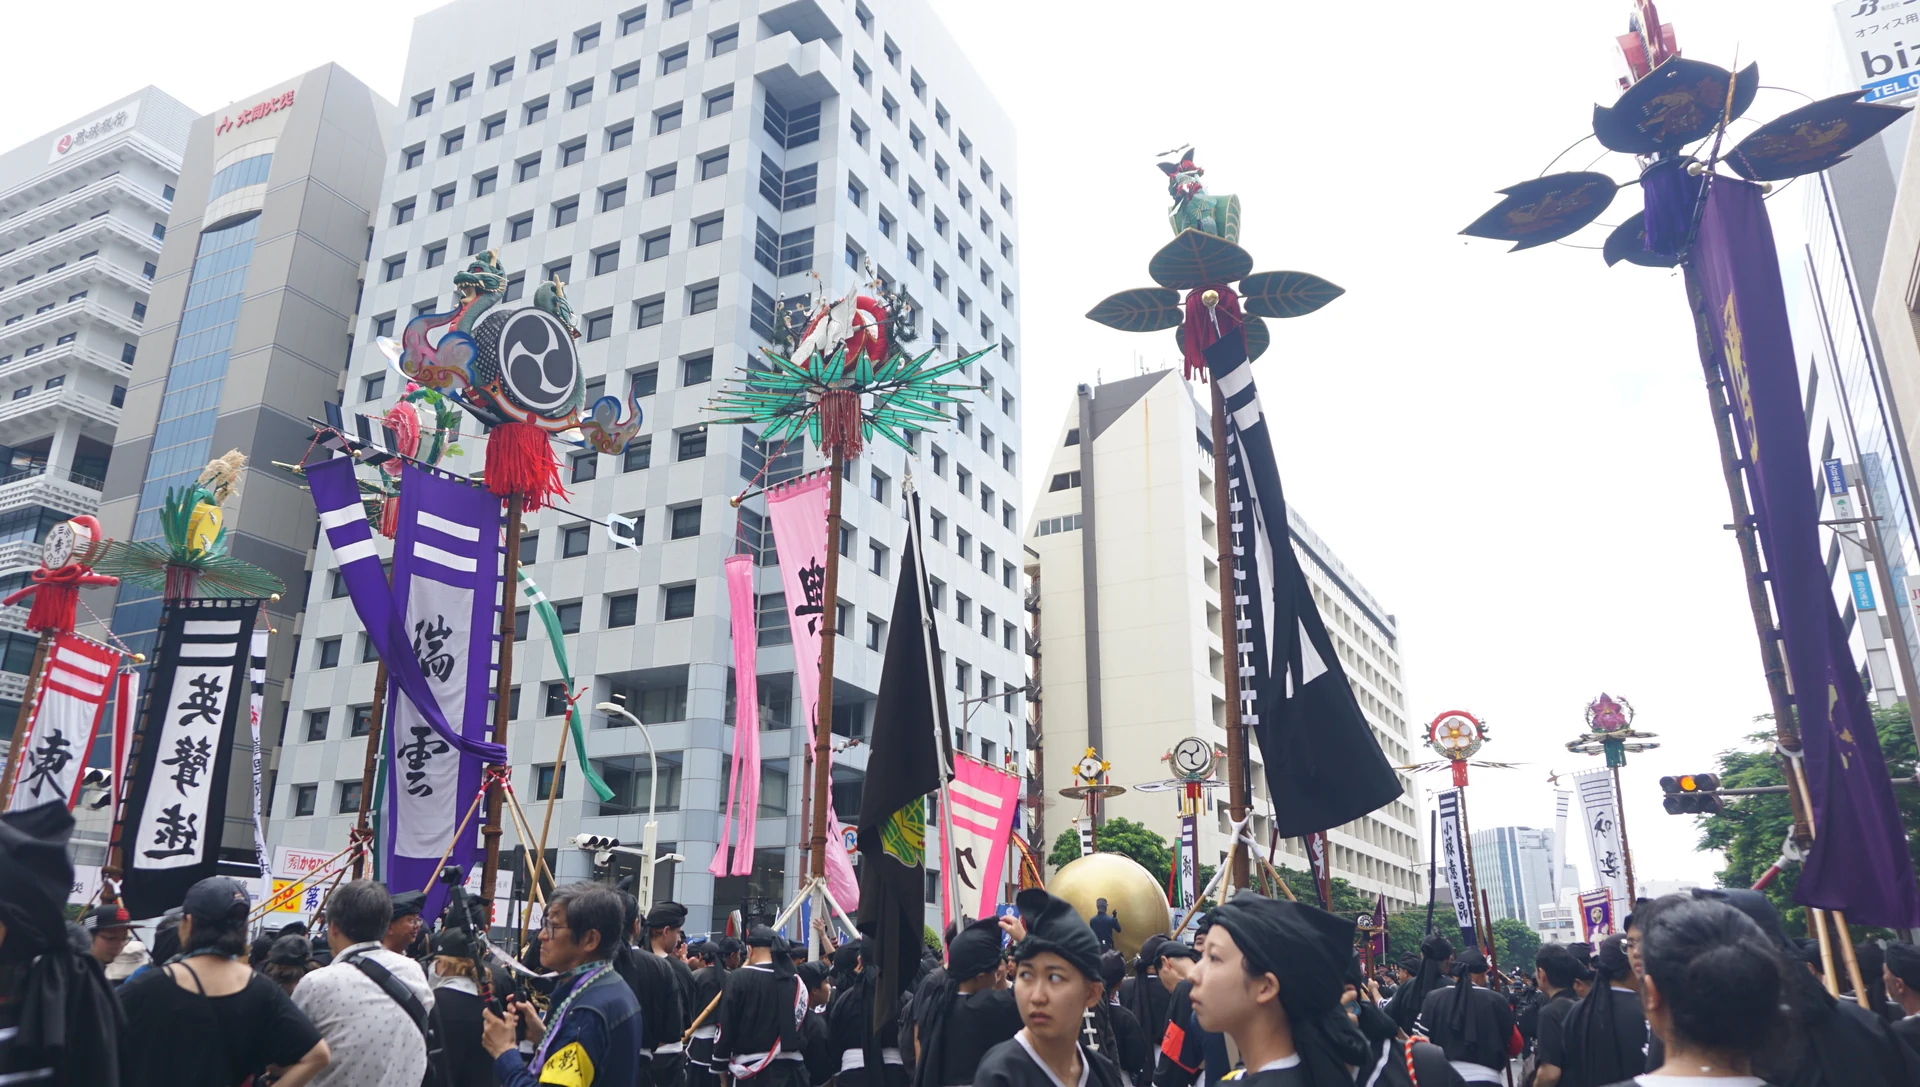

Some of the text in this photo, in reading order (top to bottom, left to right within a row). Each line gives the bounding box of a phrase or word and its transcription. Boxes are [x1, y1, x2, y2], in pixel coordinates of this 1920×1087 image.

[1855, 13, 1919, 38] オフィス用
[236, 89, 295, 128] 大同火災
[1829, 465, 1843, 493] 大日本印刷
[272, 883, 295, 910] 祝
